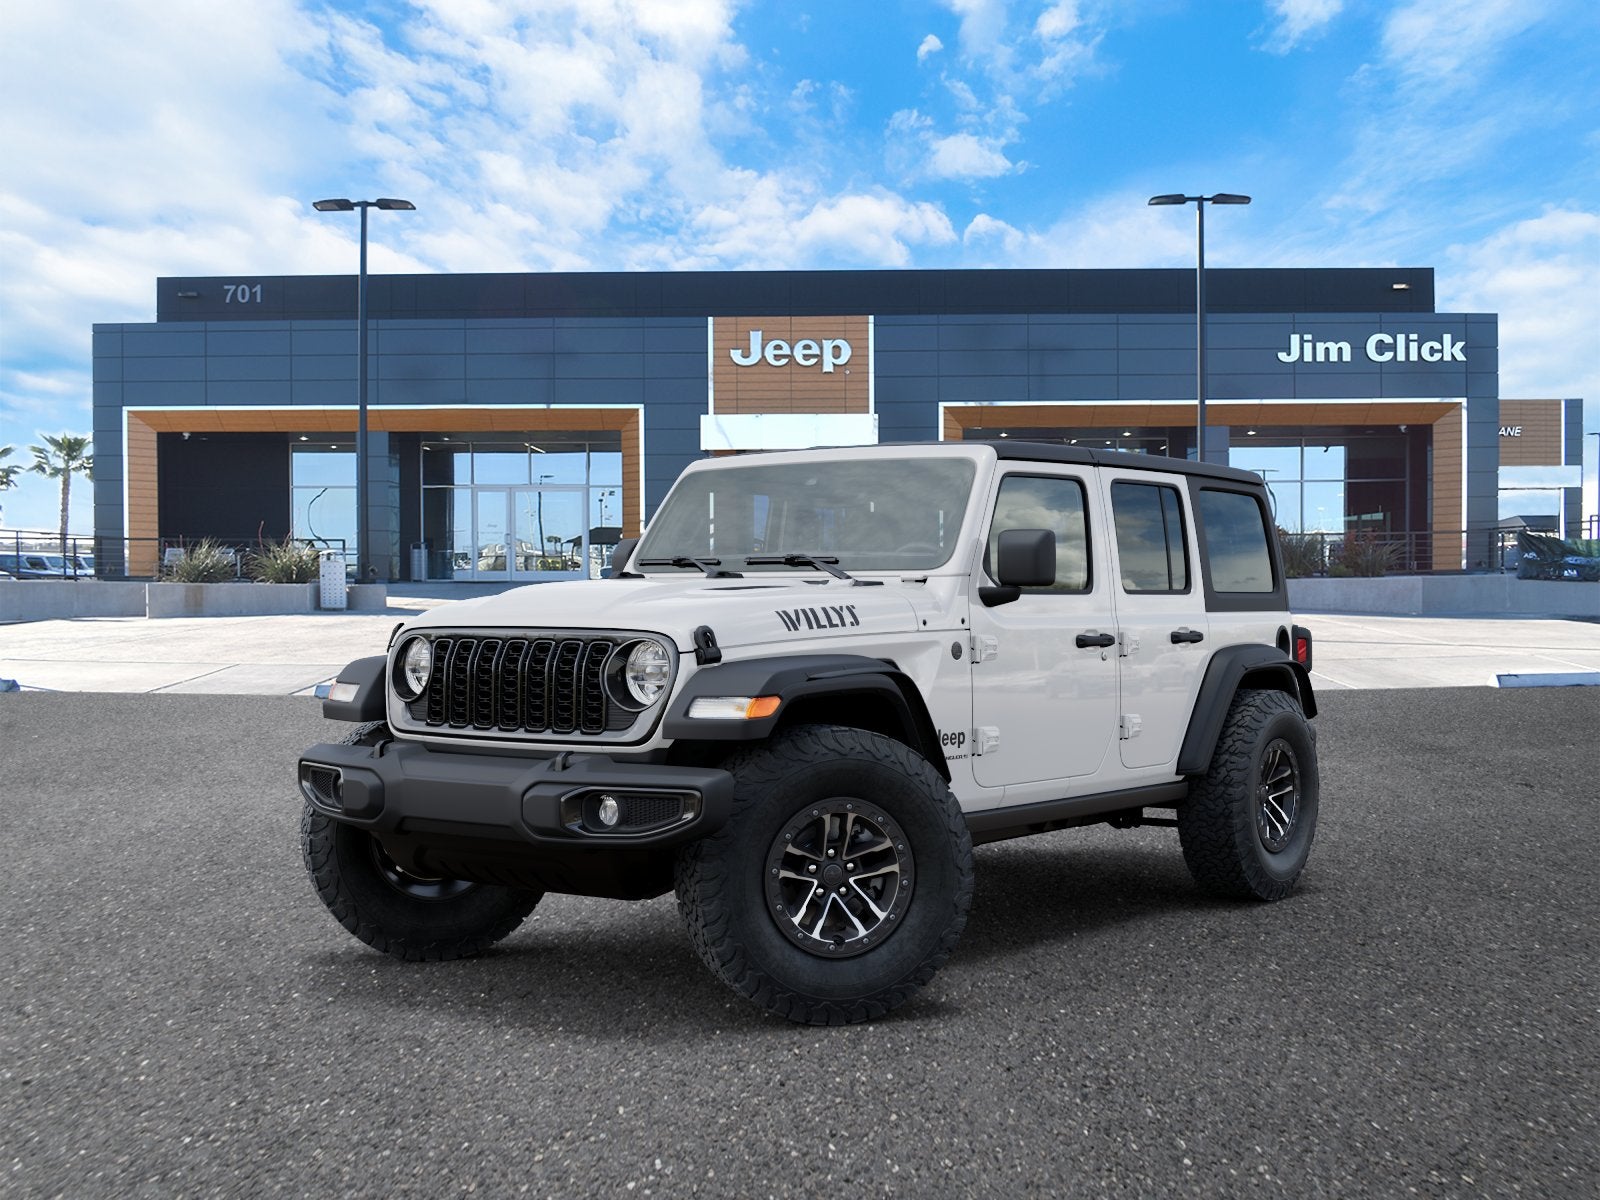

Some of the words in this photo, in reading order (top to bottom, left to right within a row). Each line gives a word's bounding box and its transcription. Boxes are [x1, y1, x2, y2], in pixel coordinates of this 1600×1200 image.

[223, 284, 262, 303] 701
[729, 330, 852, 374] Jeep
[1277, 333, 1352, 363] Jim
[1365, 333, 1467, 363] Click
[774, 604, 860, 632] WILLYS
